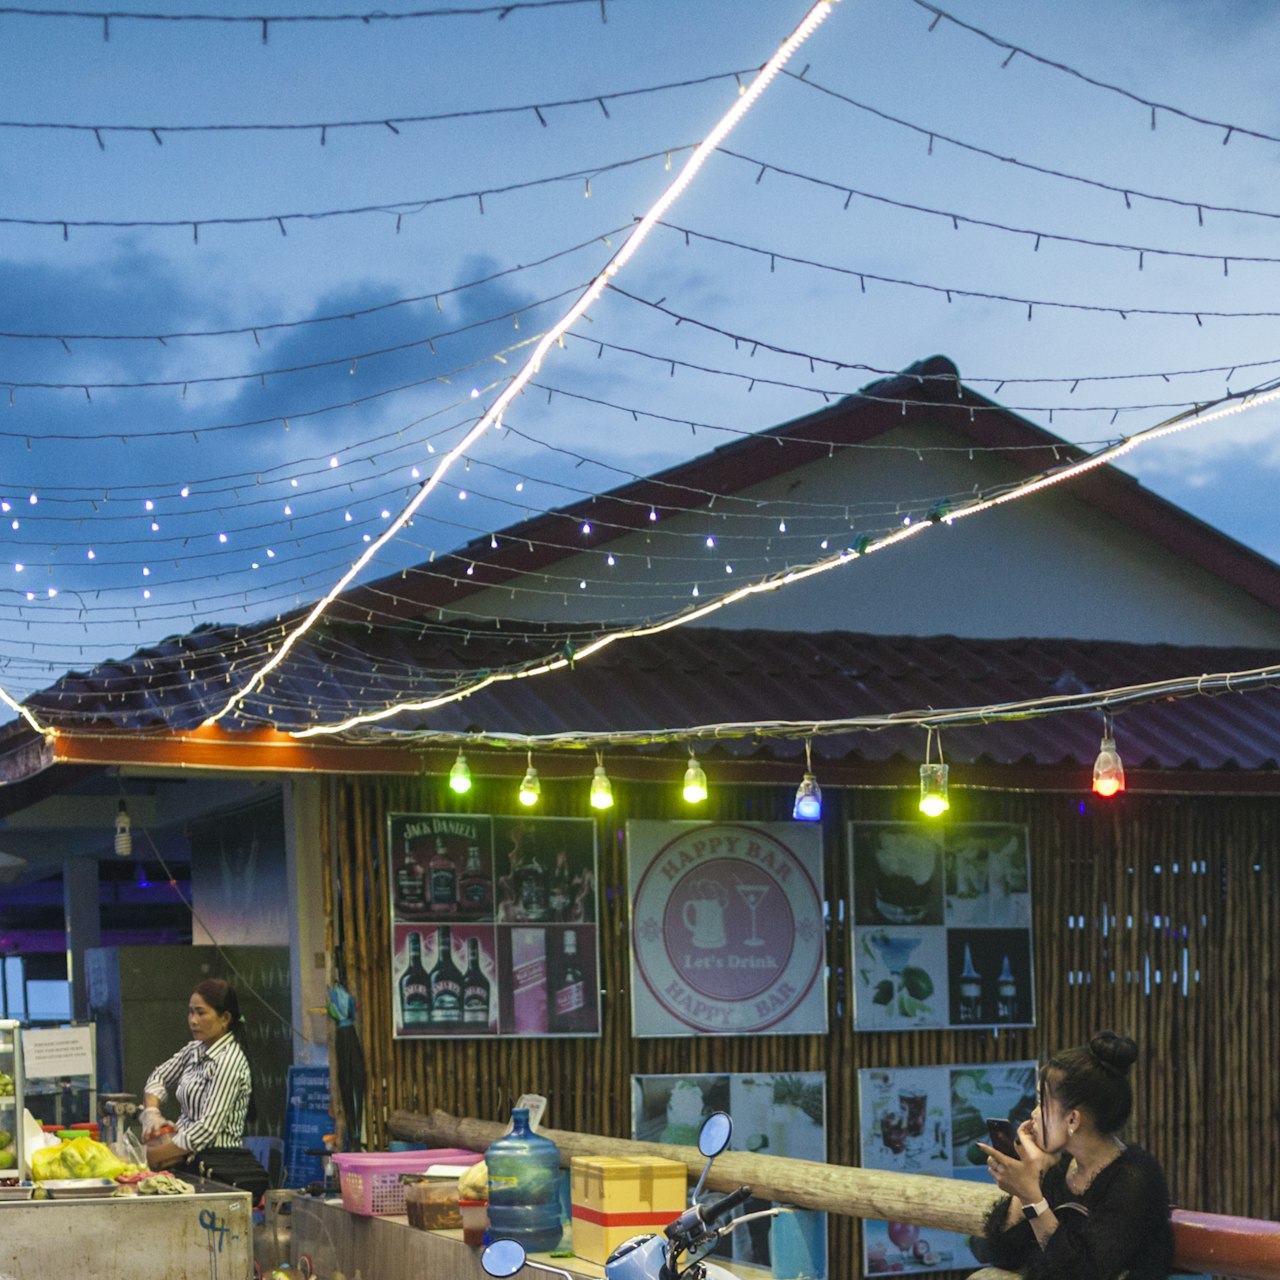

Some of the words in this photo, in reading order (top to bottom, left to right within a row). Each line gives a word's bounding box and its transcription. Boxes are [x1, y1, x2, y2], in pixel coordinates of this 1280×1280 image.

[403, 821, 432, 839] JACK
[661, 836, 740, 882] HAPPY
[747, 841, 793, 883] BAR
[684, 954, 725, 969] Let's
[728, 954, 778, 969] Drink
[665, 980, 736, 1025] HAPPY
[755, 981, 797, 1019] BAR
